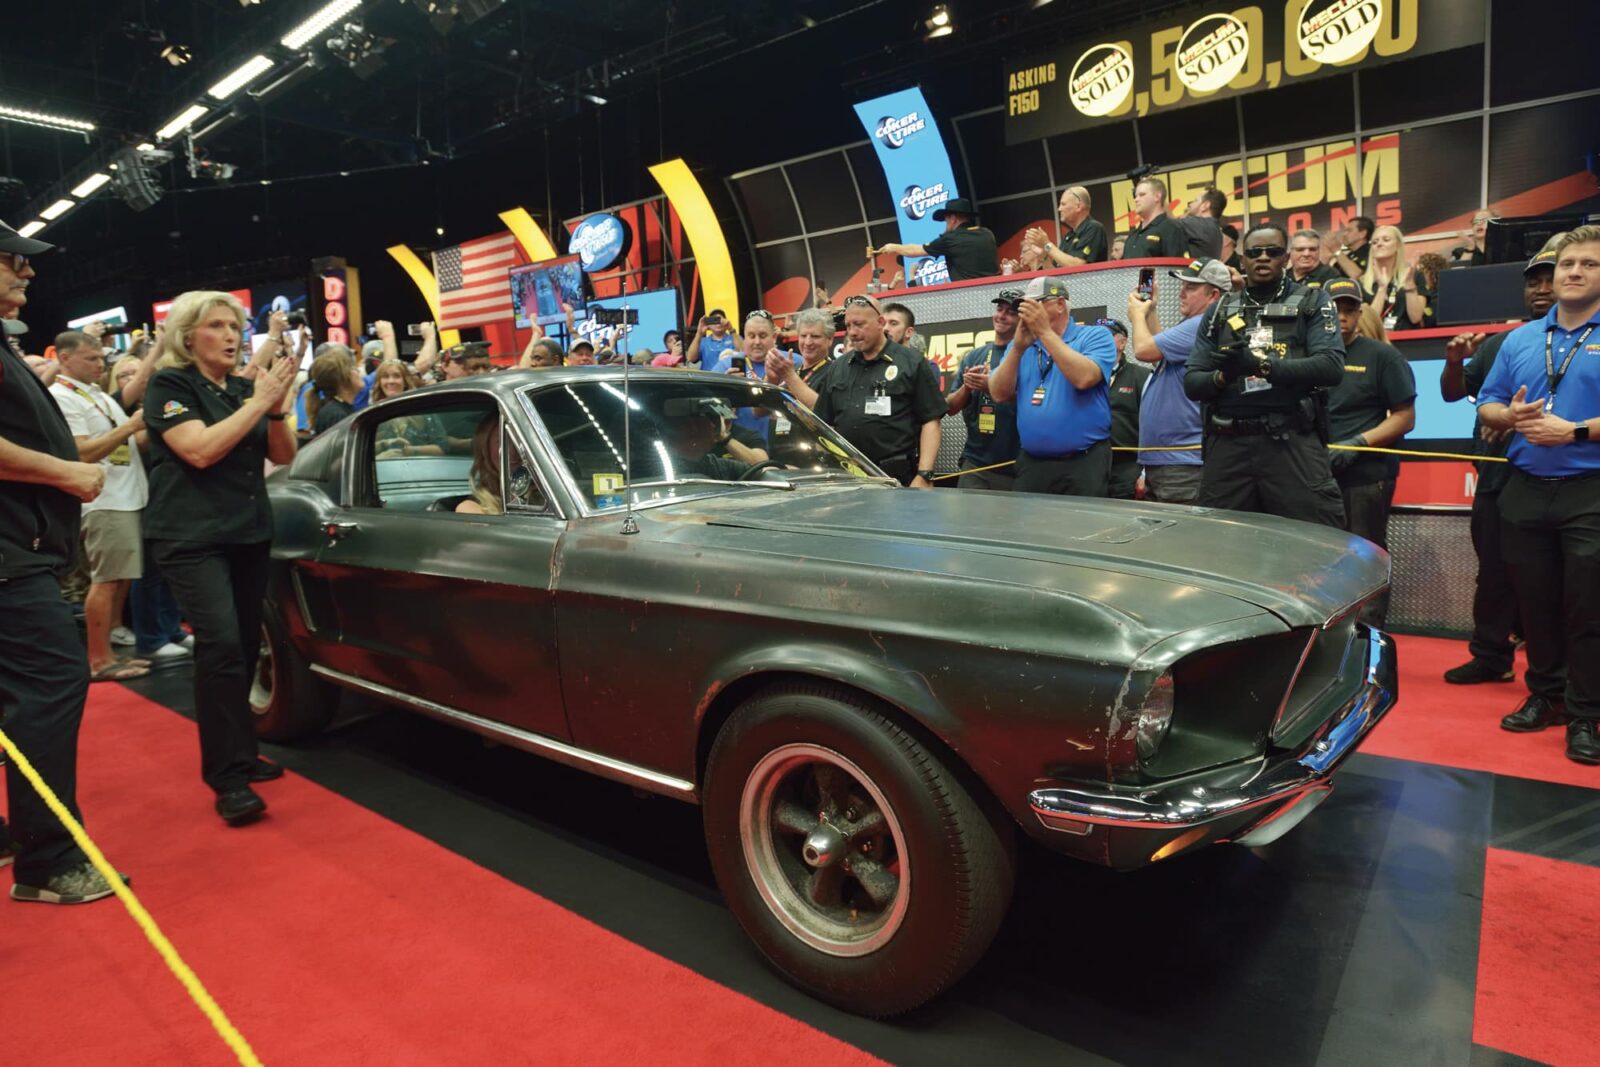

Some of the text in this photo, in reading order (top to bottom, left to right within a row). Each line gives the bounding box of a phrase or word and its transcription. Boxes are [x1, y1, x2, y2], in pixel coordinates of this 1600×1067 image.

[1308, 2, 1378, 56] SOLD
[1184, 35, 1246, 84] SOLD
[1009, 63, 1056, 92] ASKING
[1078, 64, 1130, 110] SOLD
[1009, 89, 1040, 117] F150
[875, 112, 918, 138] COKER
[894, 119, 925, 140] TIRE
[900, 183, 944, 208] COKER
[917, 192, 949, 213] TIRE
